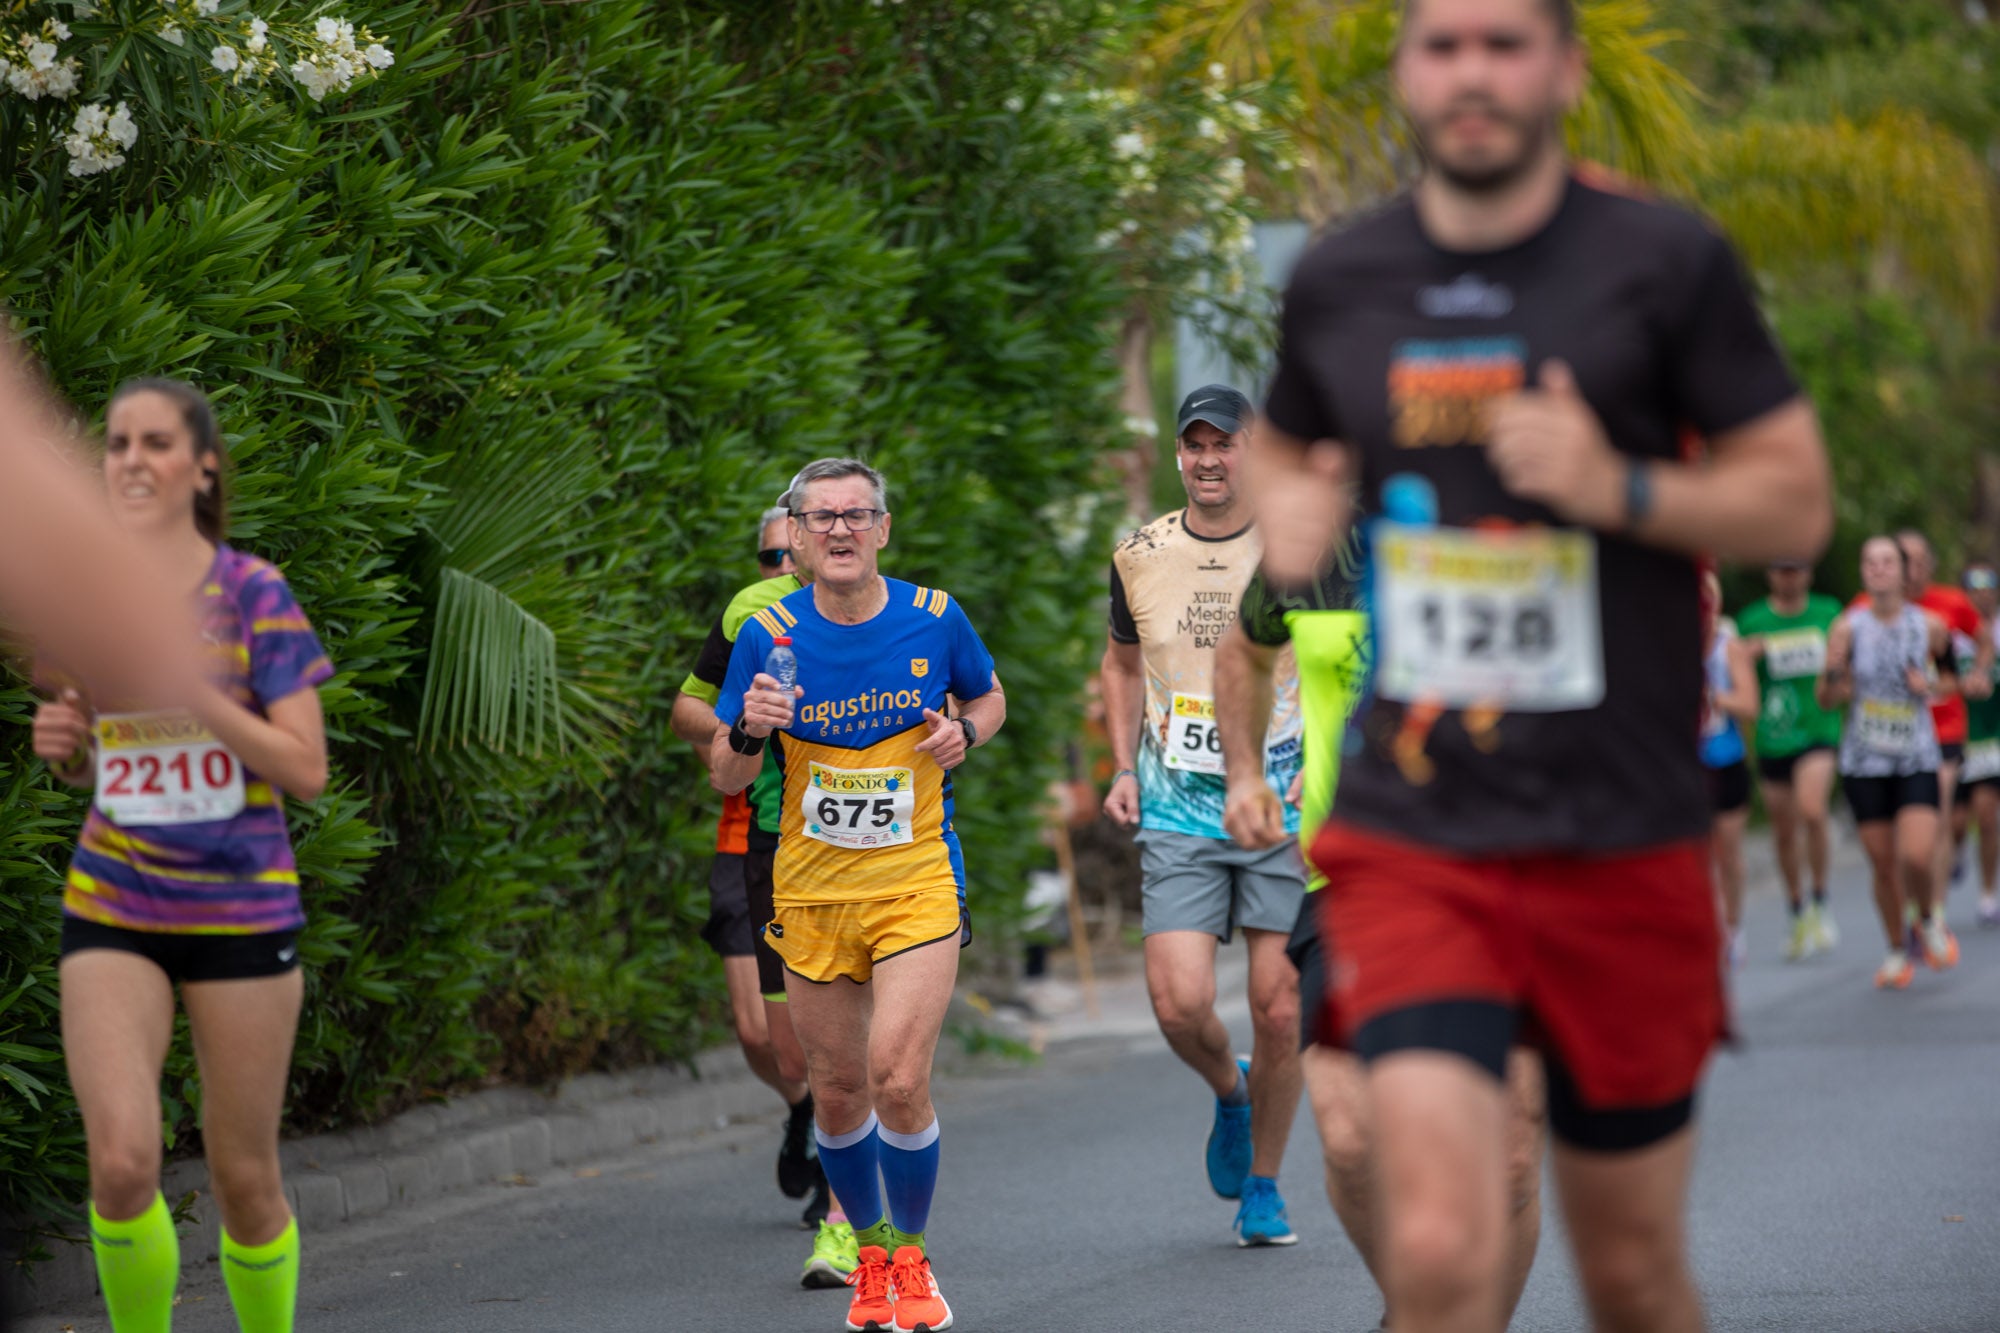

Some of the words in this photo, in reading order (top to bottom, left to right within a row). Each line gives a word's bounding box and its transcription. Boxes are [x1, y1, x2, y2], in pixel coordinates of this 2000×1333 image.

[1193, 591, 1233, 604] XLVIII
[1186, 605, 1237, 621] Media
[1194, 637, 1219, 649] BAZ
[801, 688, 922, 728] agustinos
[819, 715, 904, 737] GRANADA
[1183, 722, 1224, 754] 56
[104, 749, 233, 796] 2210
[821, 770, 833, 786] 38
[817, 796, 895, 828] 675
